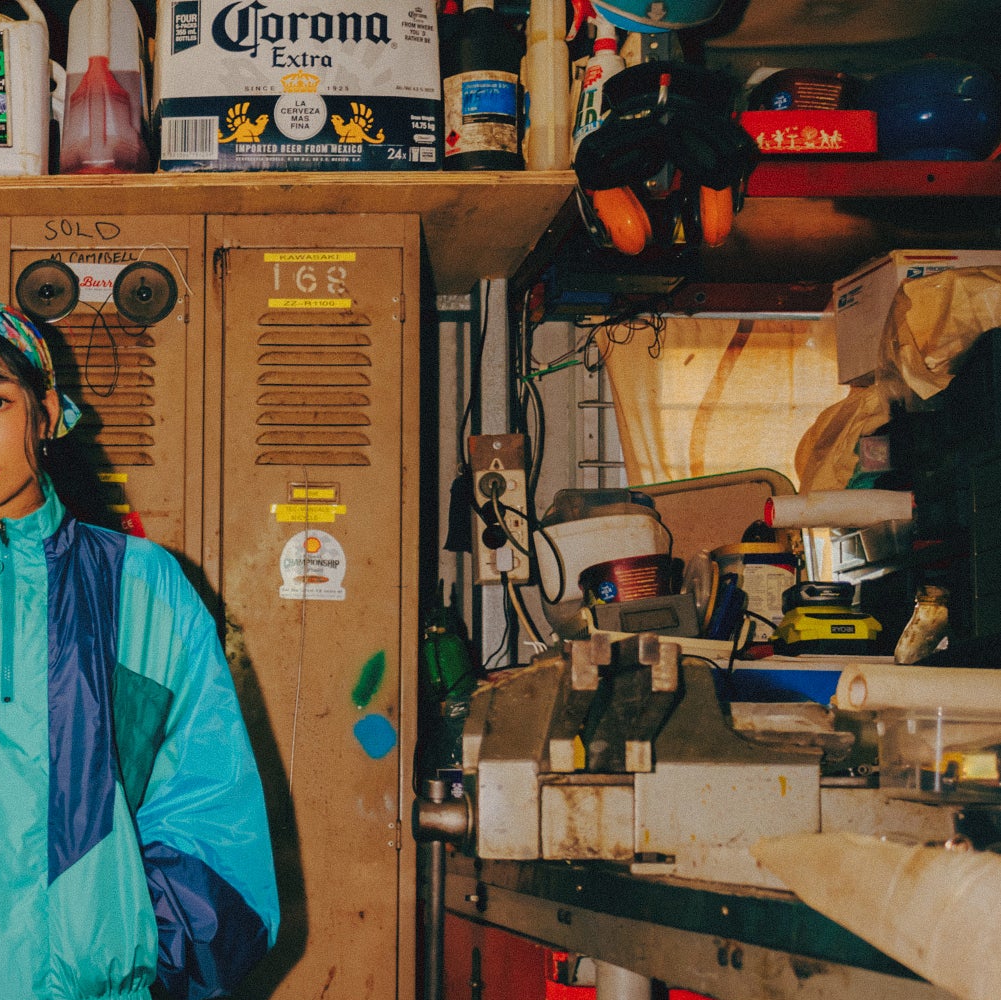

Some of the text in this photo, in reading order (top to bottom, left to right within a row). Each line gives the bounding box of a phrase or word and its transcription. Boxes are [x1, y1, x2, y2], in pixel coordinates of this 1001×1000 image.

[176, 14, 197, 23] FOUR
[211, 1, 391, 58] Corona
[271, 47, 333, 68] Extra
[235, 144, 362, 153] IMPORTED BEER FROM MEXICO
[45, 219, 121, 240] SOLD
[69, 251, 138, 264] CAMPBELL
[273, 263, 348, 294] 168
[283, 558, 340, 569] CHAMPIONSHIP
